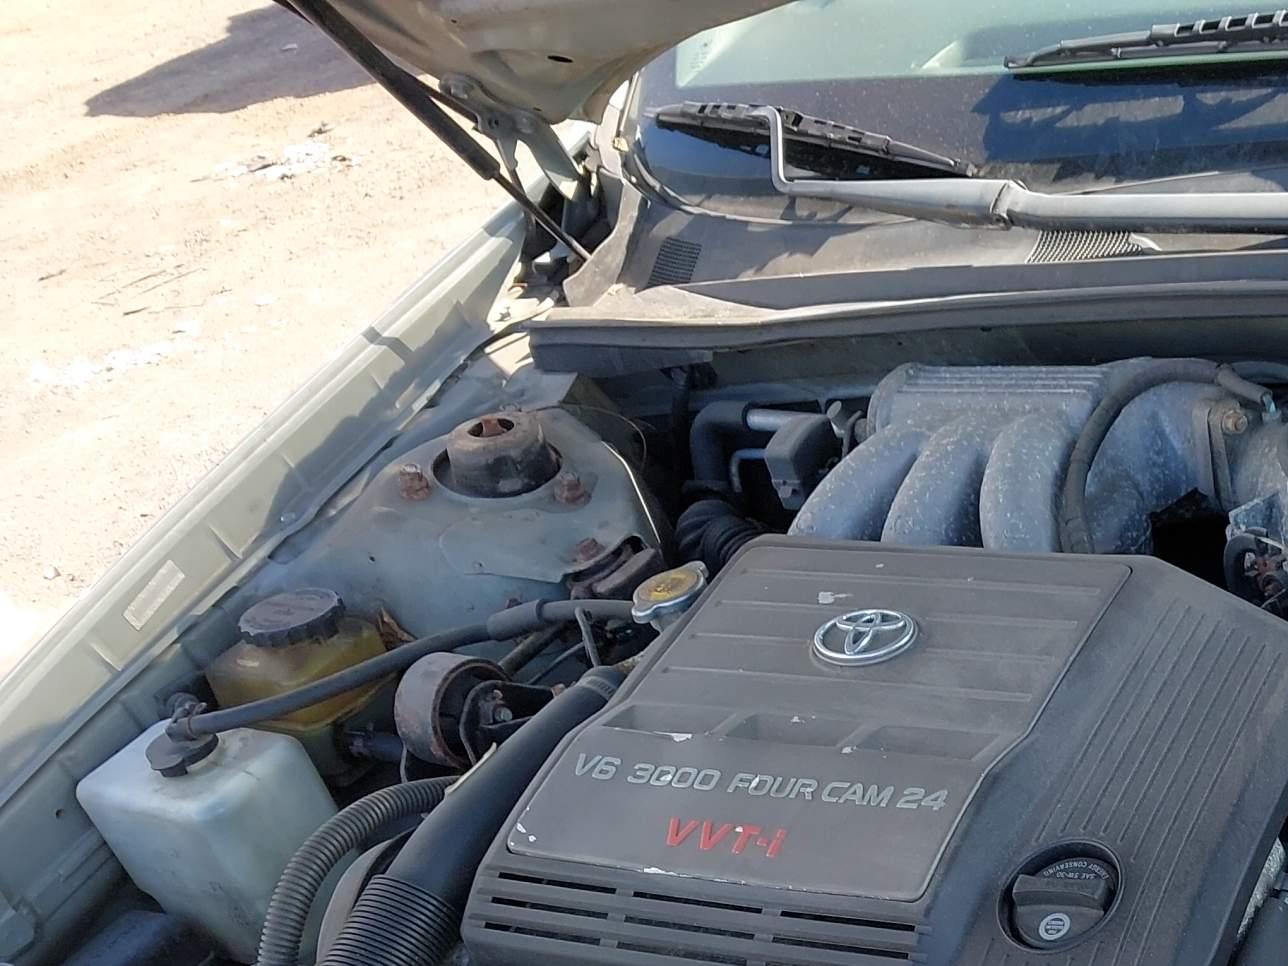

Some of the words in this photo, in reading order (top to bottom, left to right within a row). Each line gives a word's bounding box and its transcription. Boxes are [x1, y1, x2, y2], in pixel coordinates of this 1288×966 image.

[574, 752, 622, 780] V6
[627, 763, 721, 791] 3000
[727, 773, 819, 801] FOUR
[821, 781, 895, 808] CAM
[896, 787, 950, 812] 24
[664, 816, 788, 859] VVT-i
